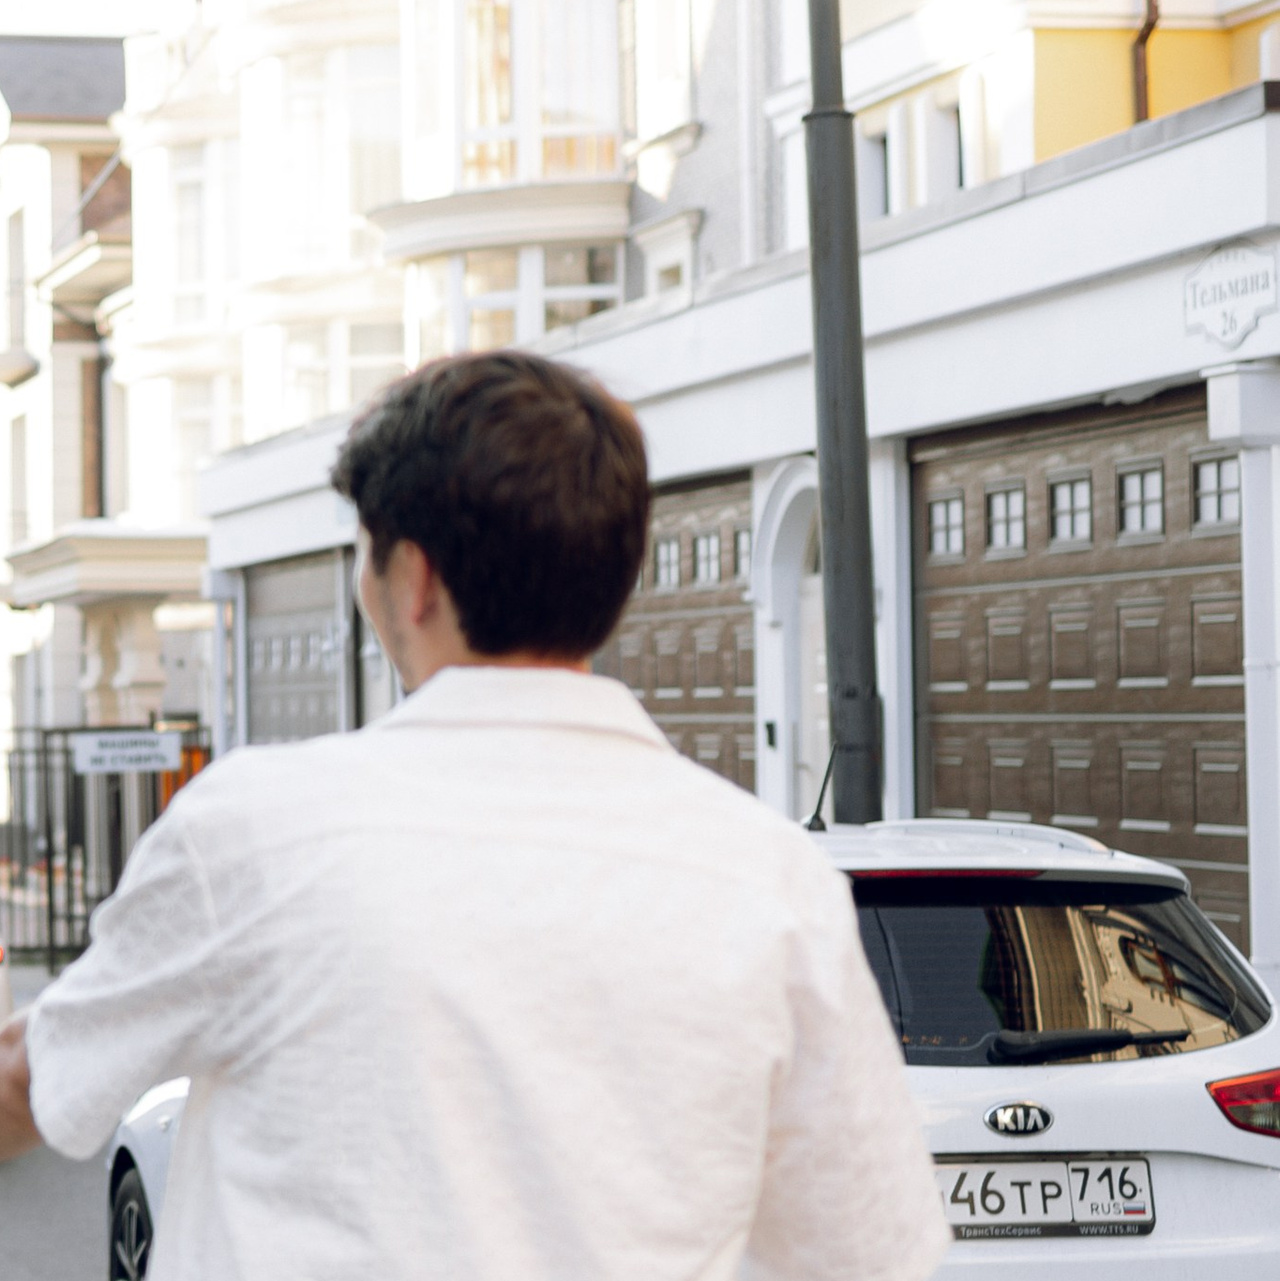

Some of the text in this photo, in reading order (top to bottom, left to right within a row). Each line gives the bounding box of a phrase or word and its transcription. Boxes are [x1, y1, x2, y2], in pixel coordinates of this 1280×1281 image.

[1189, 270, 1270, 310] Тельмана
[996, 1106, 1045, 1132] KIA
[949, 1167, 1138, 1216] 46ТР 716
[1090, 1202, 1122, 1215] RUS
